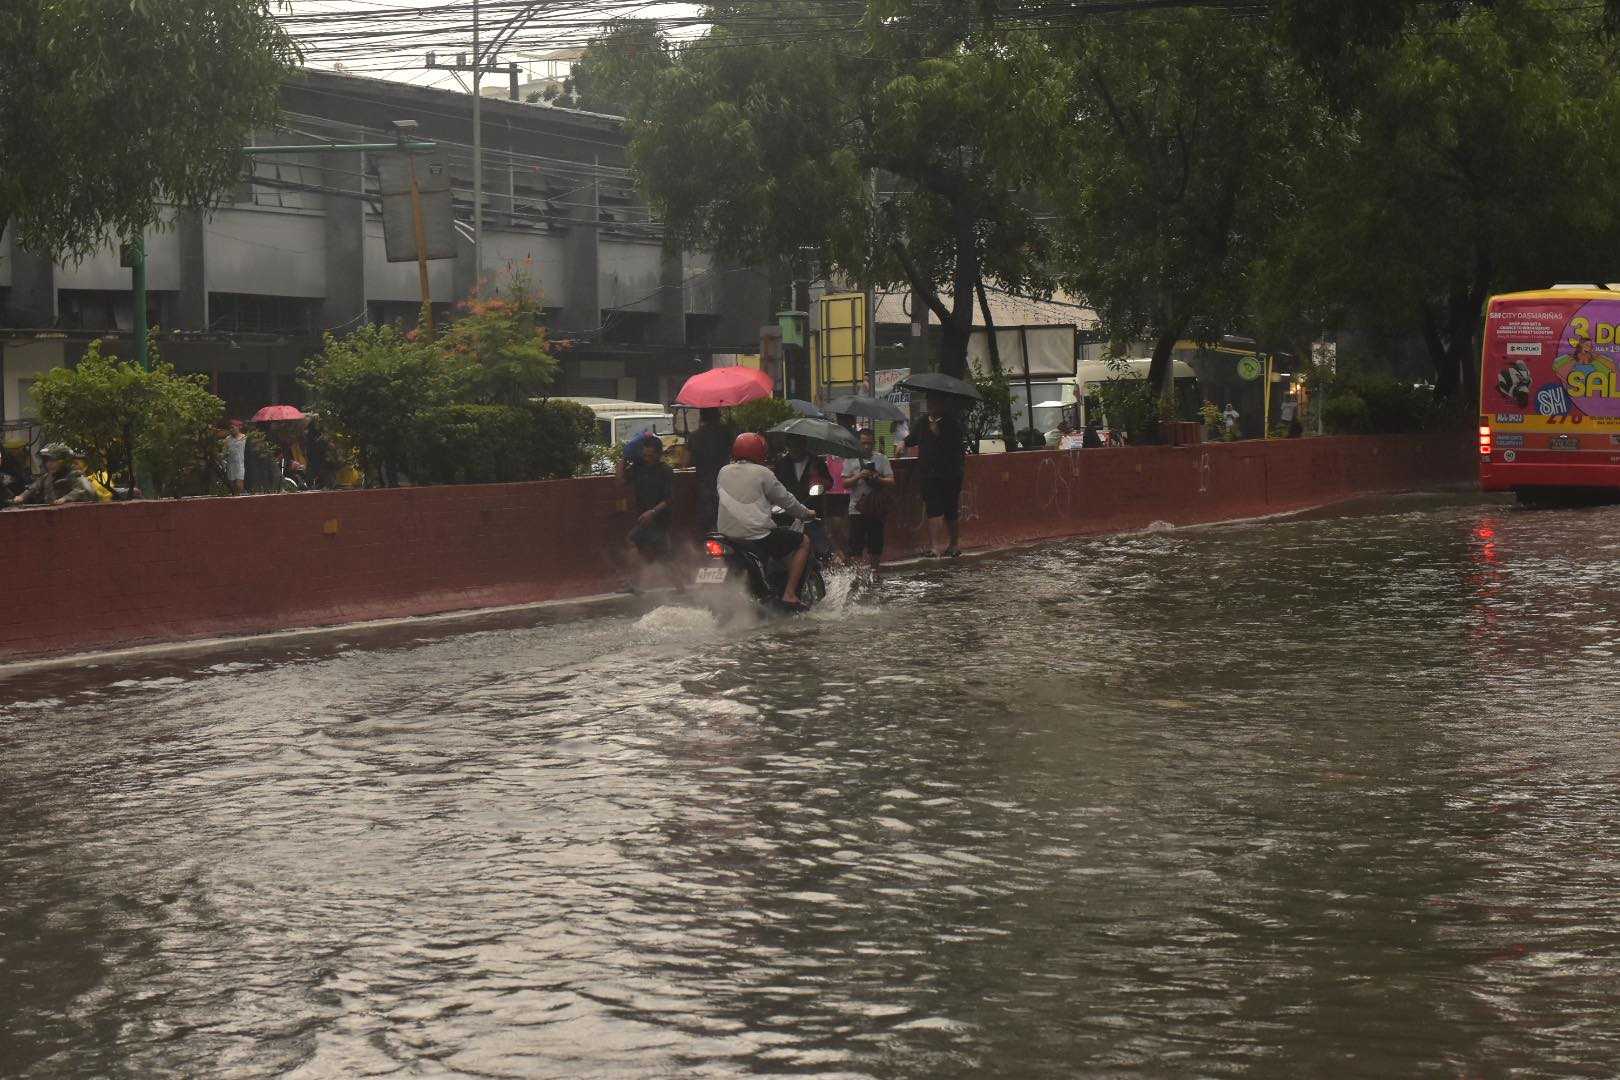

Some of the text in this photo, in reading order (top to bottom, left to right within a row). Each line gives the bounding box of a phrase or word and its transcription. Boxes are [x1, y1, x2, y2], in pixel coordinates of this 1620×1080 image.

[1568, 317, 1620, 348] 3 D
[1537, 386, 1567, 416] SM
